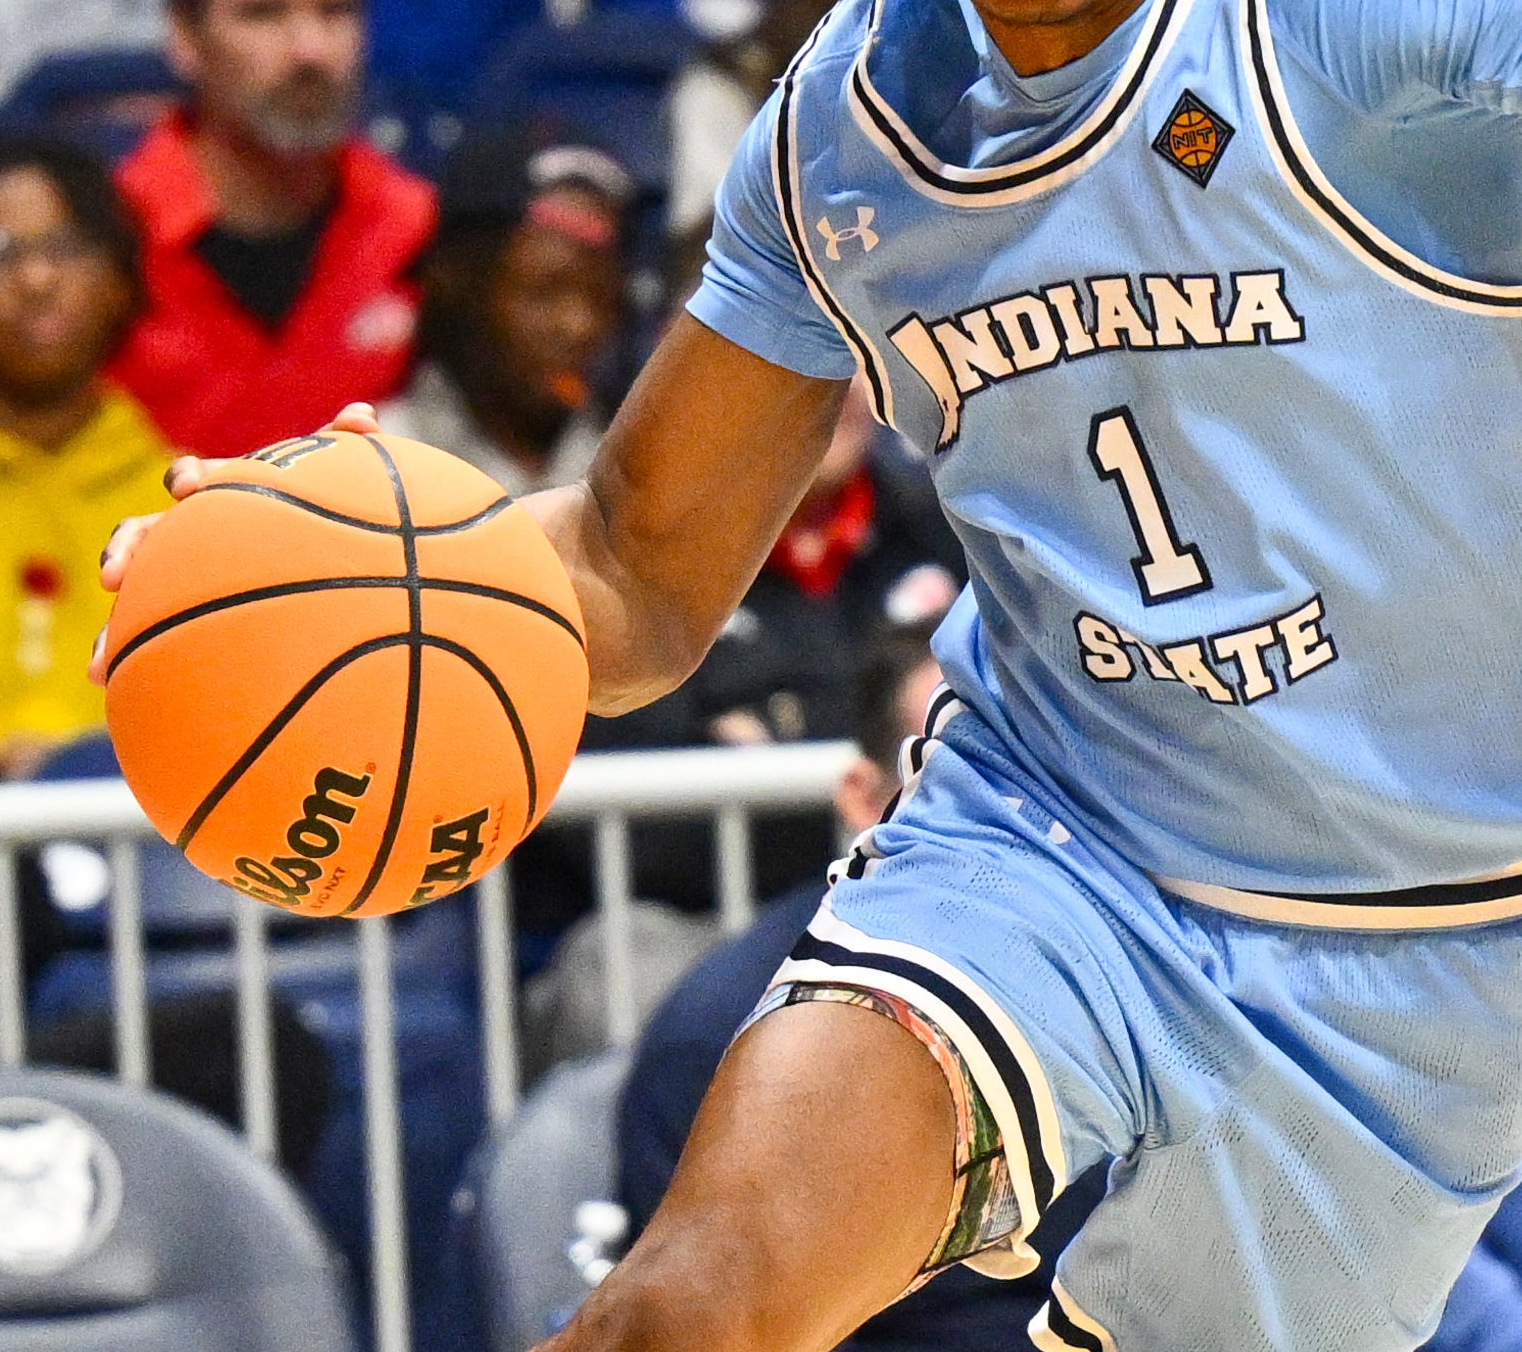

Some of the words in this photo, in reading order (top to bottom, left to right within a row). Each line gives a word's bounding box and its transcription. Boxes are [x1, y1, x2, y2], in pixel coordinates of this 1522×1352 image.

[1172, 127, 1214, 150] NIT
[887, 269, 1306, 455] INDIANA
[1087, 404, 1213, 607] 1
[1073, 593, 1340, 707] STATE
[230, 766, 371, 906] ilson
